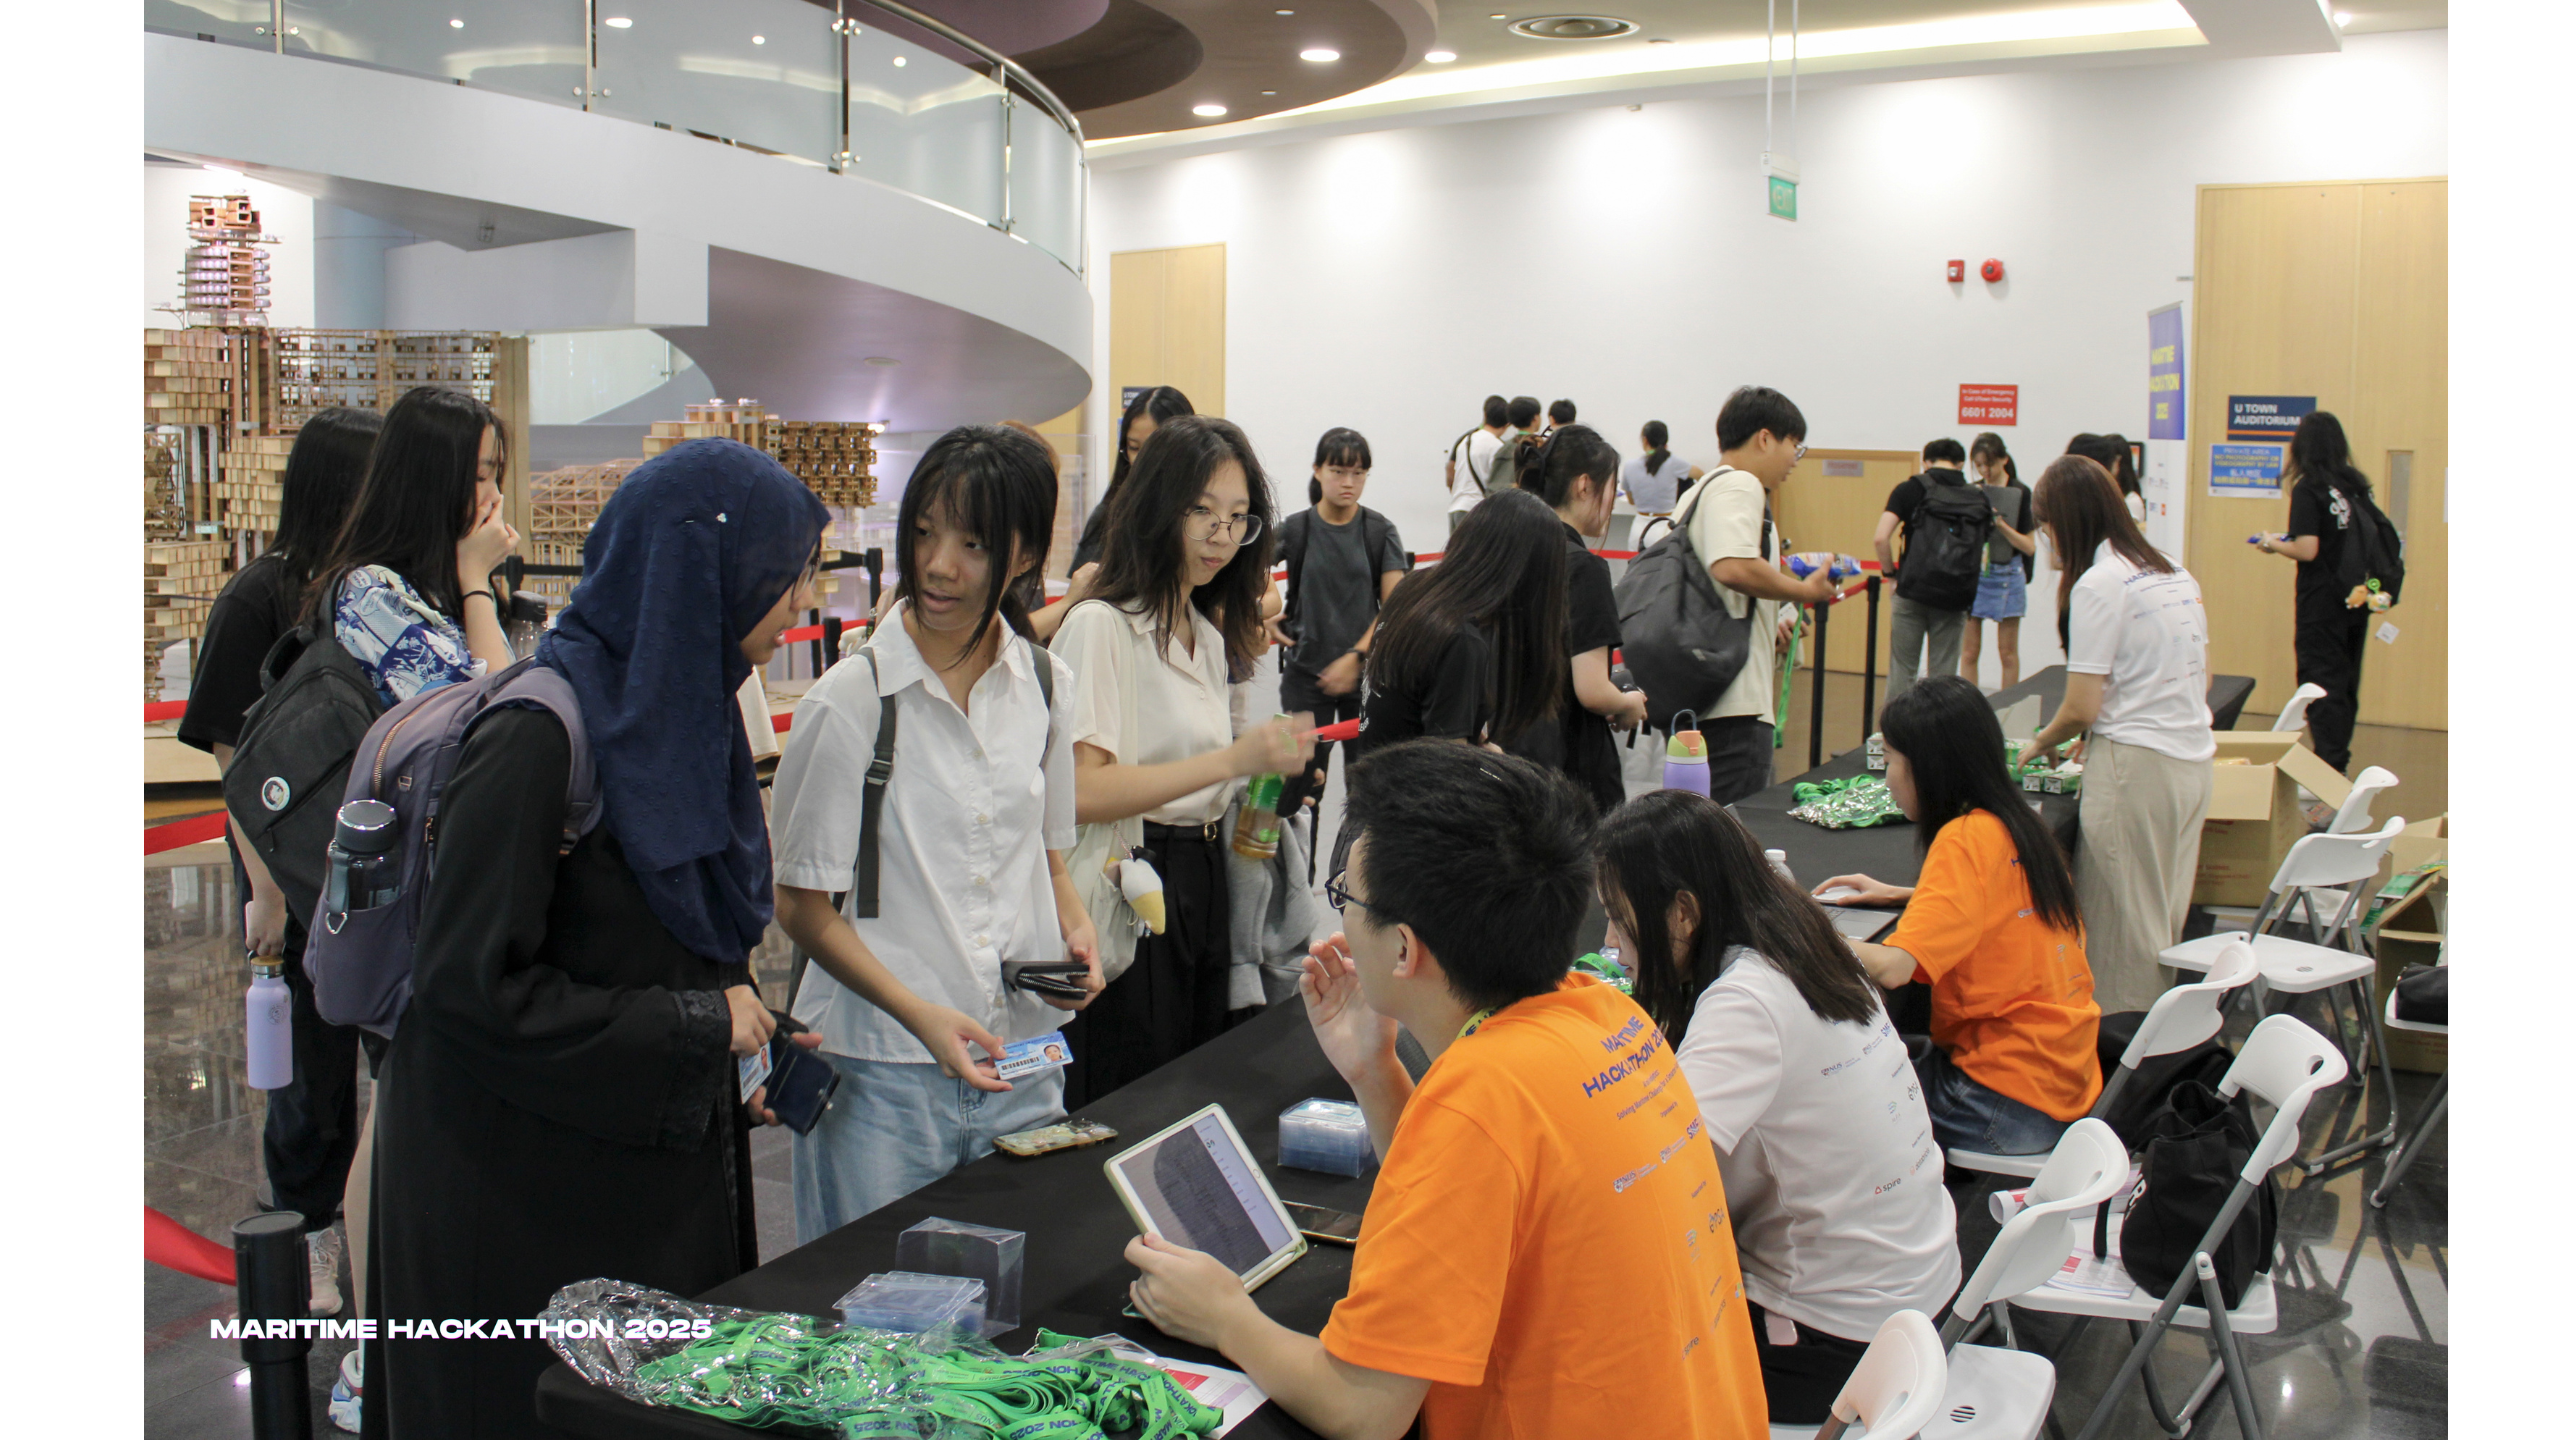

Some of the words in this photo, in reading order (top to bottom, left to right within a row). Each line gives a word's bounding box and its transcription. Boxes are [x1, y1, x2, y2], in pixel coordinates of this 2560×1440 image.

[1962, 407, 1985, 417] 6601
[1988, 408, 2014, 418] 2004
[2234, 404, 2243, 413] U
[2245, 404, 2278, 414] TOWN
[2234, 415, 2301, 426] AUDITORIUM
[1883, 1178, 1902, 1192] spire
[854, 1420, 891, 1433] 2025
